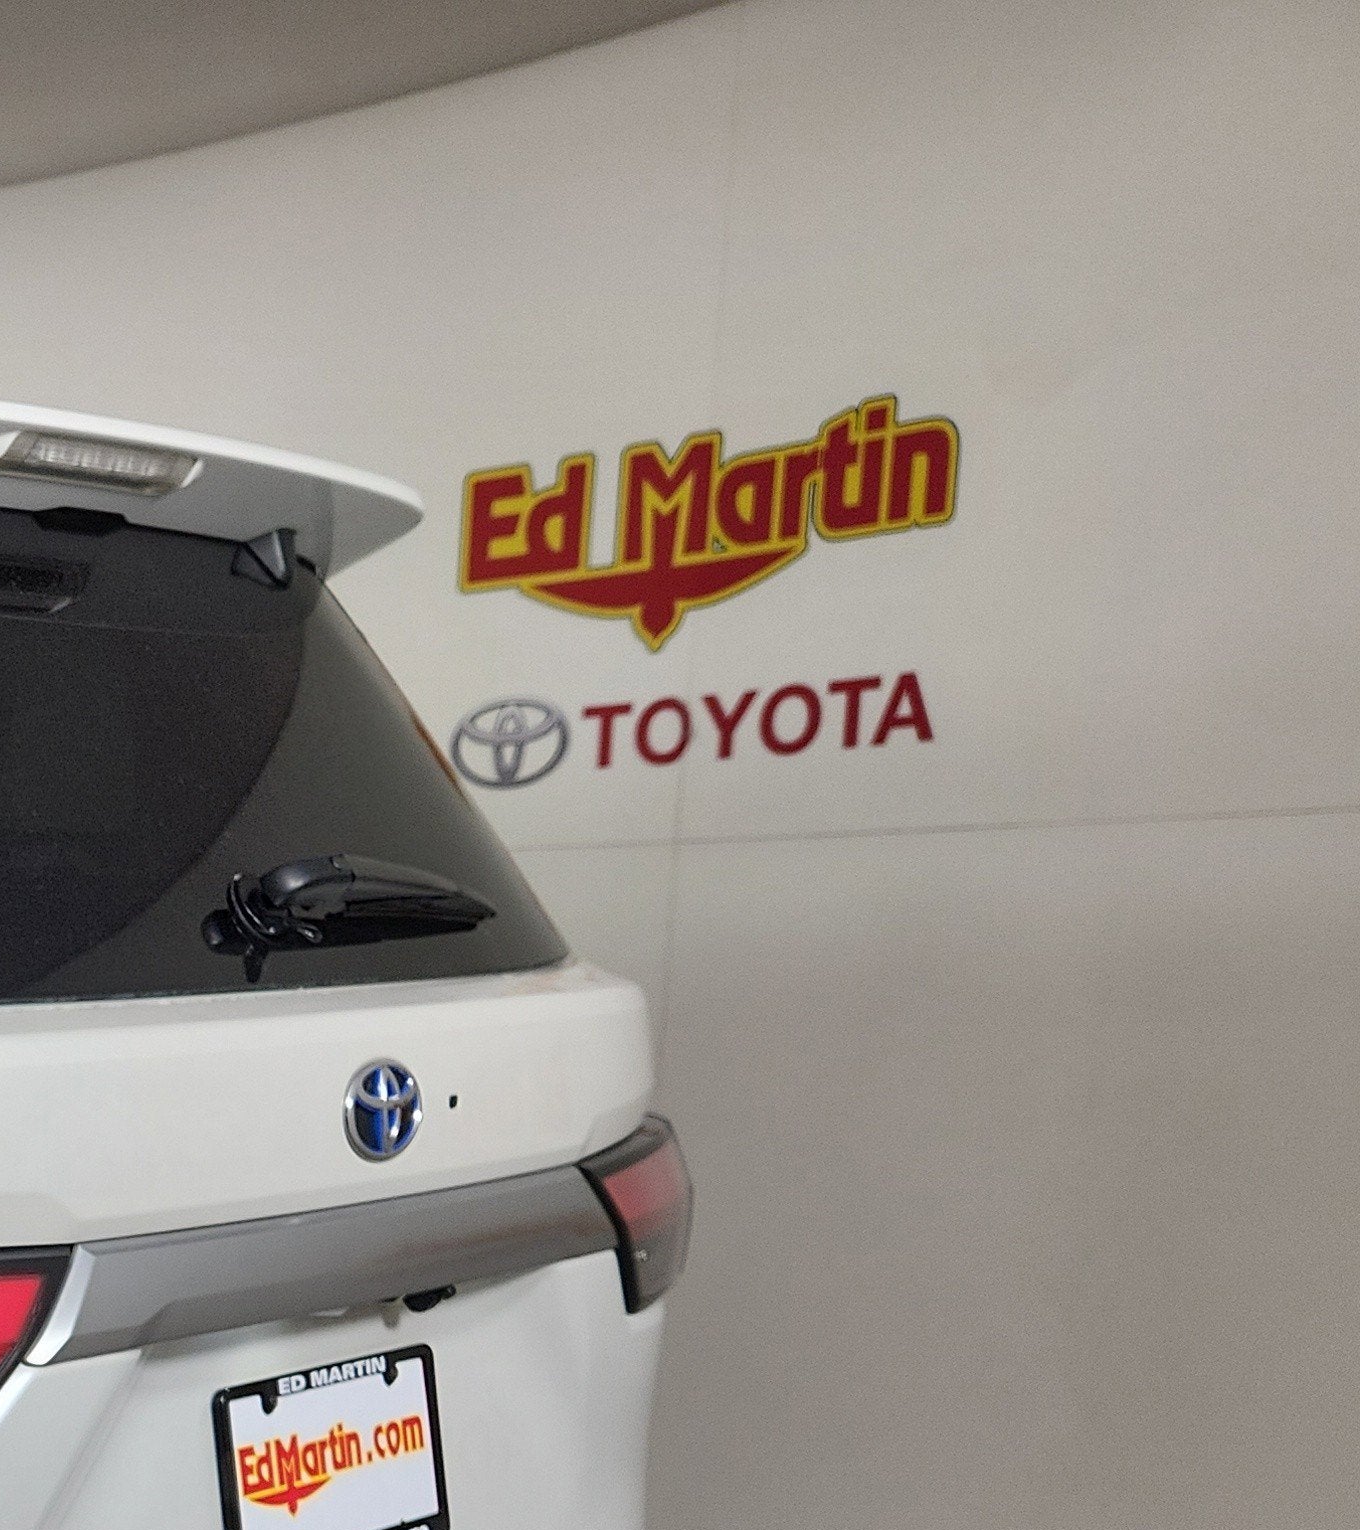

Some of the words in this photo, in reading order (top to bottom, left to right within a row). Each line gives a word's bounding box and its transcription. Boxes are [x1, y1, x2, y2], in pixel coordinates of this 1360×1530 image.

[458, 453, 596, 592] Ed
[612, 394, 960, 570] Martin
[584, 672, 933, 768] TOYOTA
[277, 1377, 307, 1396] ED
[309, 1355, 387, 1387] MARTIN
